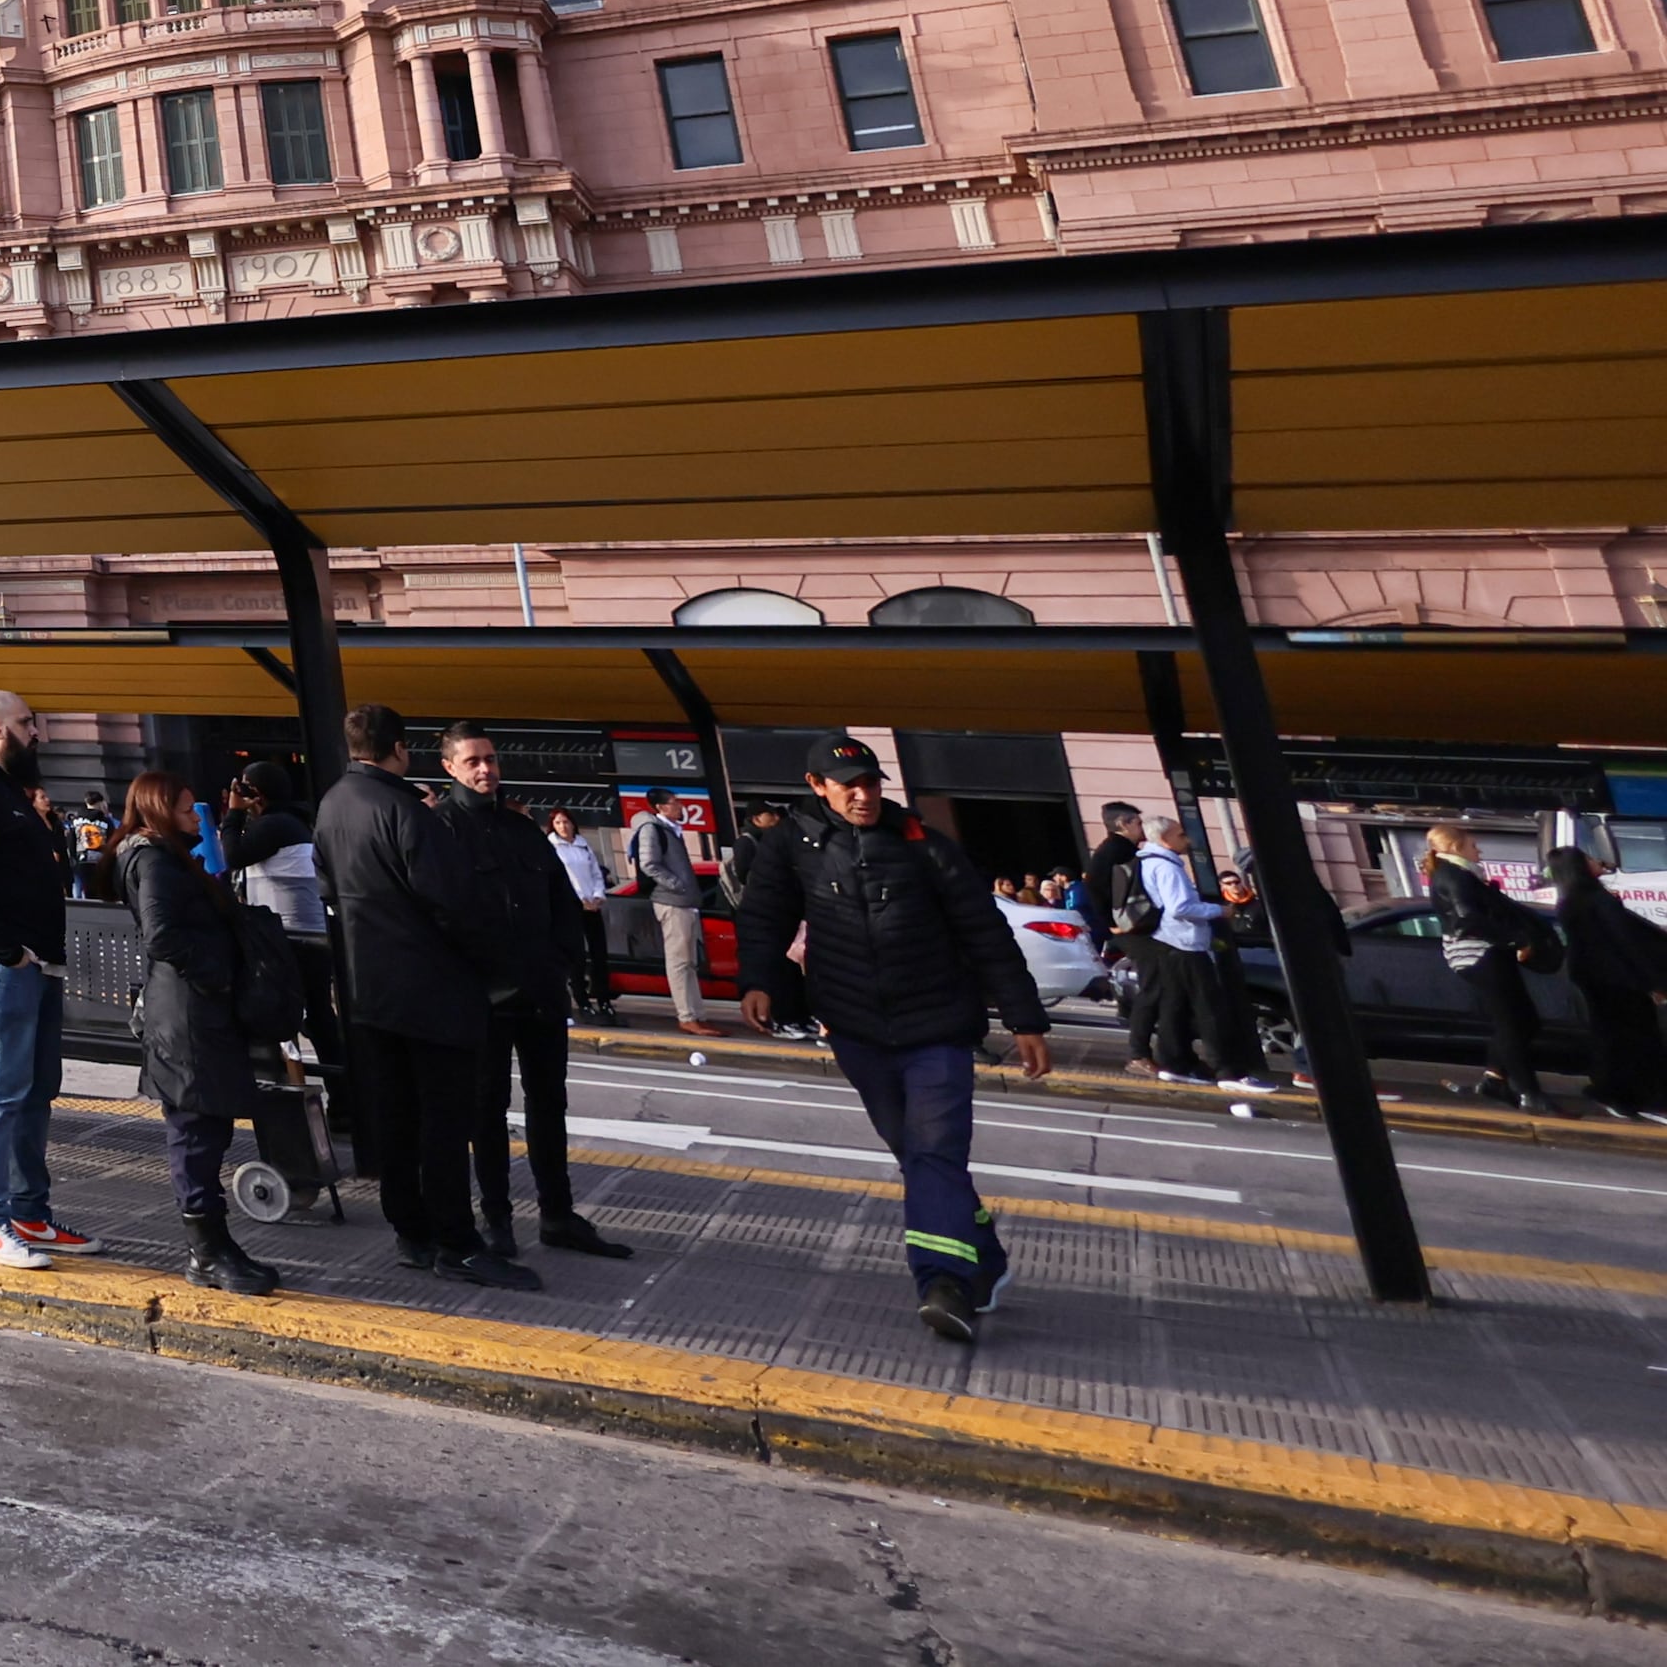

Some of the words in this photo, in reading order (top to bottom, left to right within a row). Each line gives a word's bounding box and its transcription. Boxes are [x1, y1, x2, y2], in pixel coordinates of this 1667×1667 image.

[161, 591, 212, 610] Plaza
[665, 748, 697, 770] 12
[1488, 863, 1504, 876] EL
[1503, 877, 1530, 890] NO
